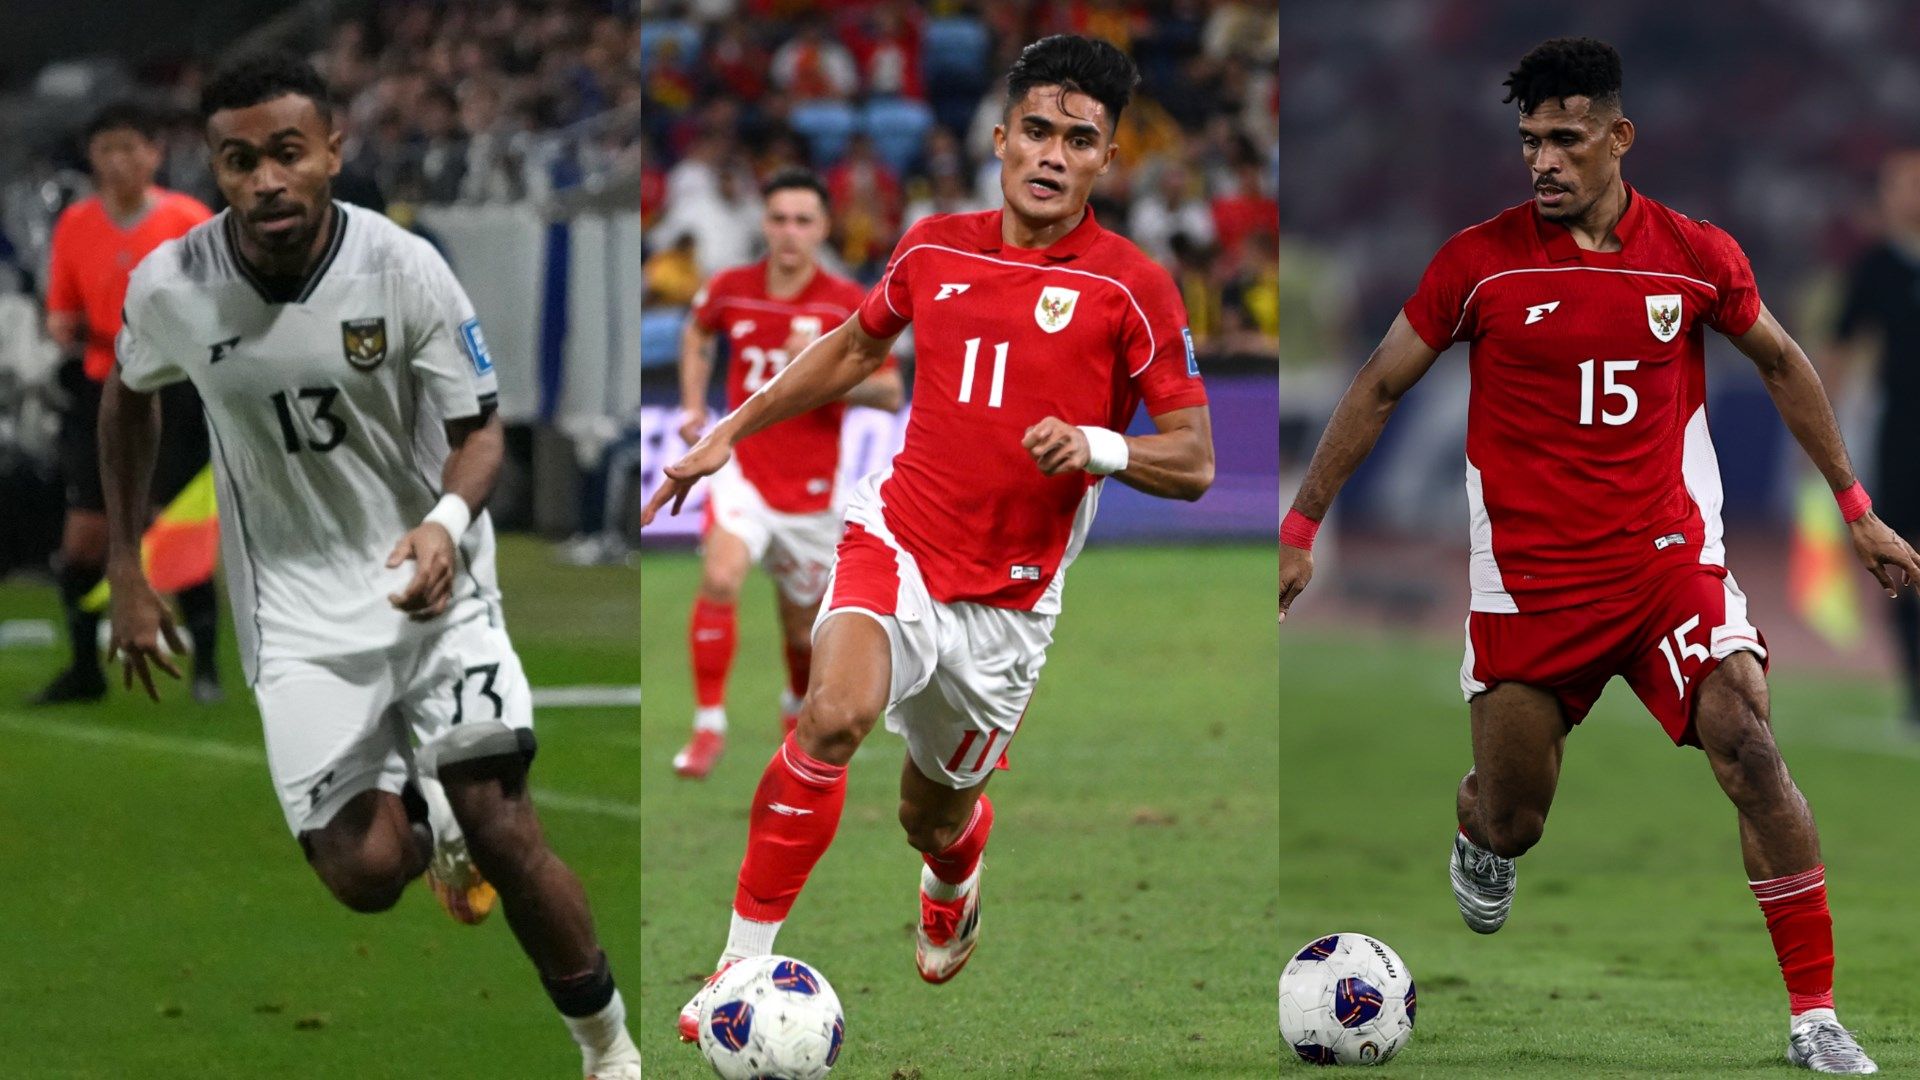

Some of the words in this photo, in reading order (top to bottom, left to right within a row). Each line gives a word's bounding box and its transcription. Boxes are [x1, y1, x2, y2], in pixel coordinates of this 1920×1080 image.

[958, 336, 1009, 408] 11
[1577, 358, 1640, 426] 15
[269, 387, 347, 454] 13
[1658, 613, 1711, 701] 15
[451, 661, 503, 726] 13
[945, 727, 1002, 772] 11
[1364, 938, 1397, 978] molten
